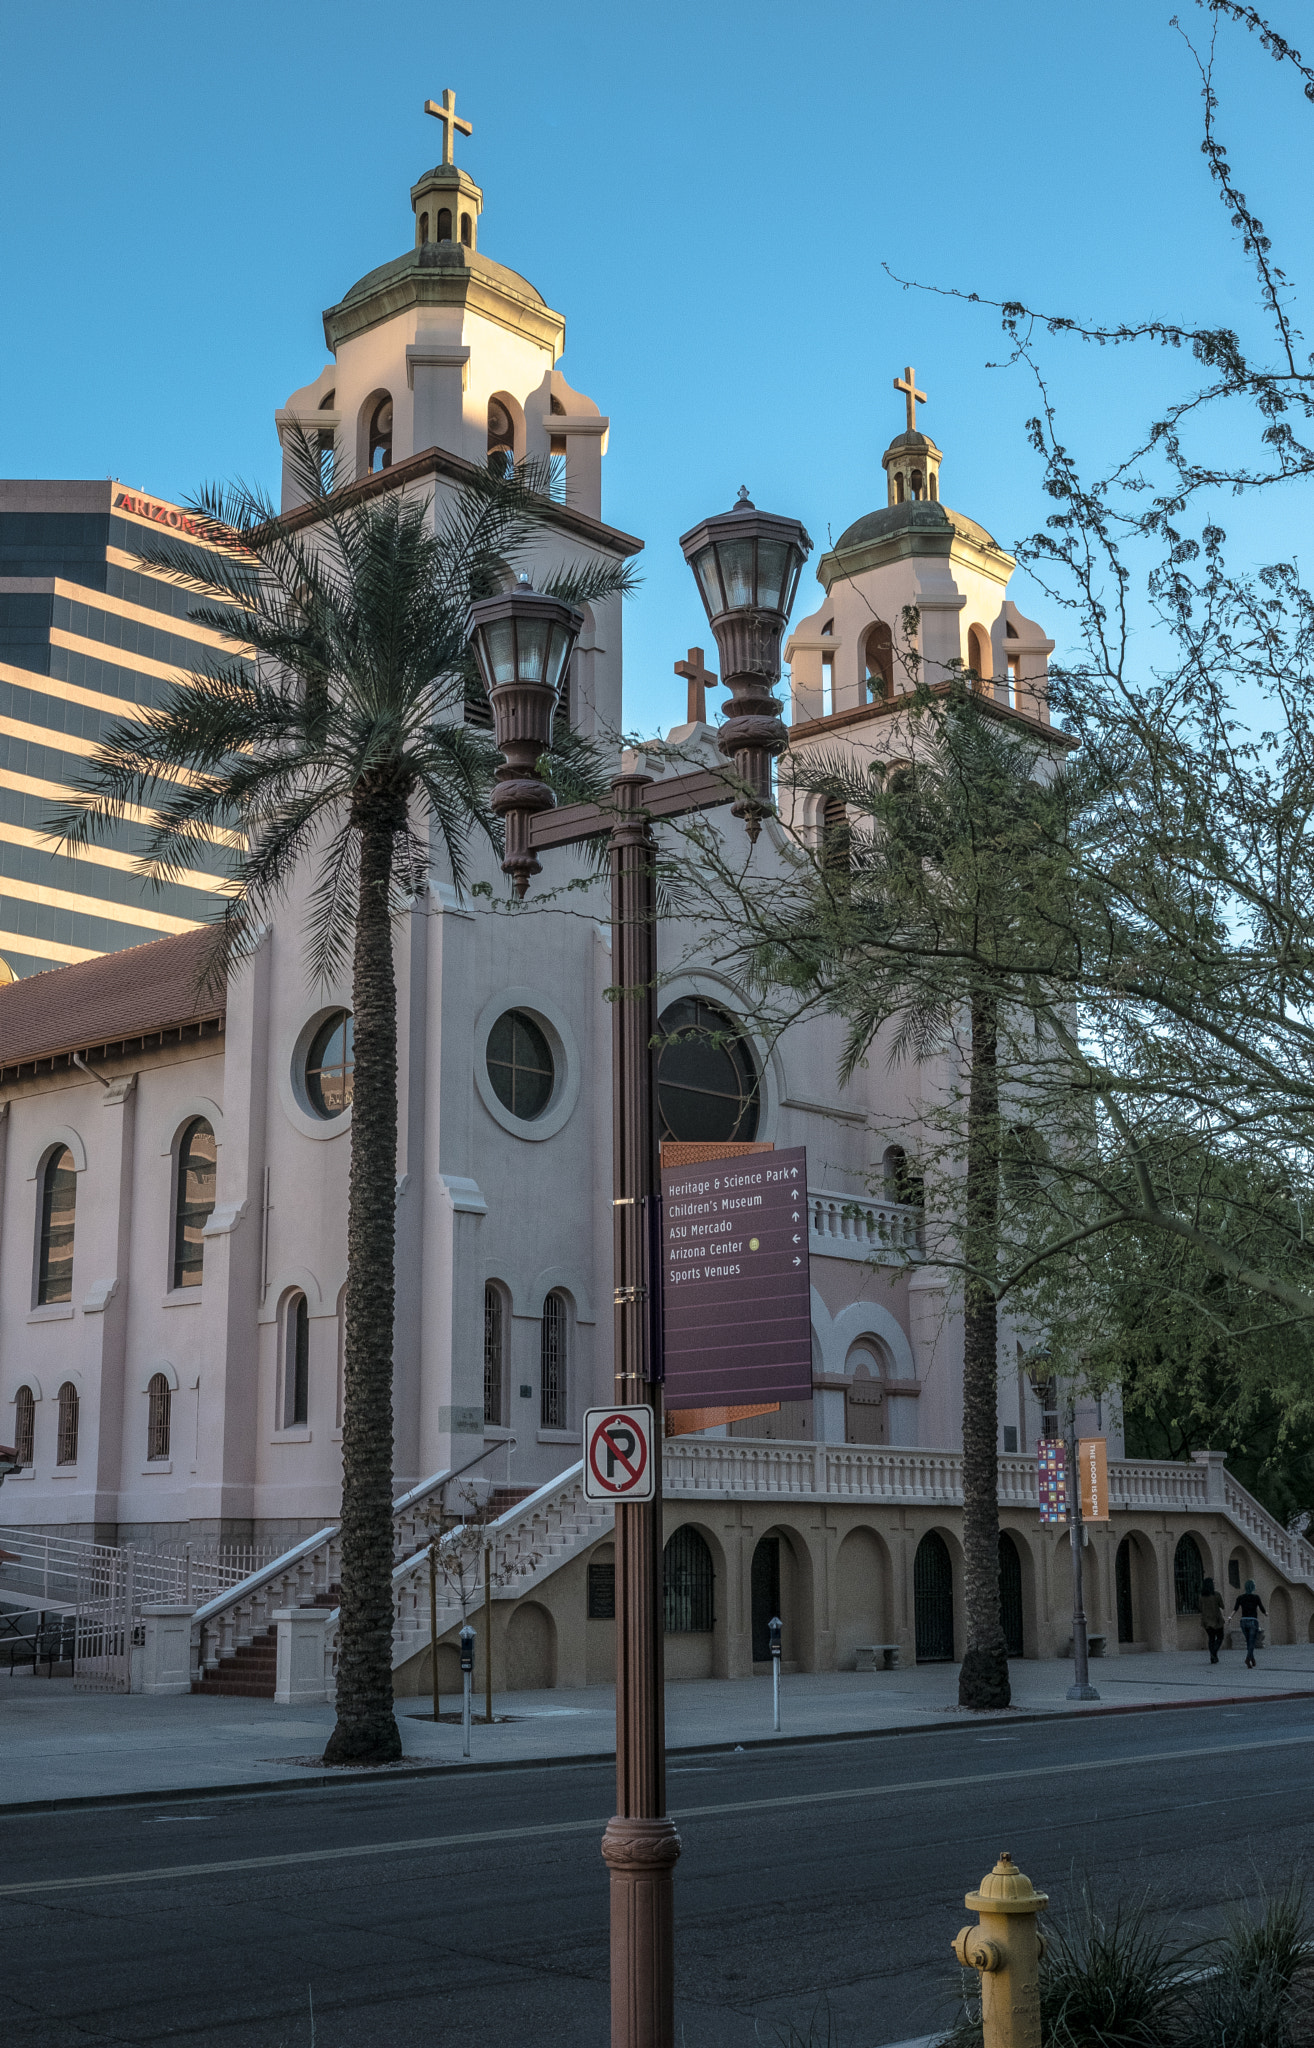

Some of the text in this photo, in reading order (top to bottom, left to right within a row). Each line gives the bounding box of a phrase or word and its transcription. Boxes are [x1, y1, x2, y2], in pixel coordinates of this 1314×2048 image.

[669, 1167, 789, 1197] Heritage & Science Park
[669, 1196, 762, 1217] Children's Museum
[670, 1220, 732, 1239] ASU Mercado
[669, 1241, 743, 1260] Arizona Center
[670, 1264, 741, 1284] Sports Venues
[607, 1428, 636, 1478] P
